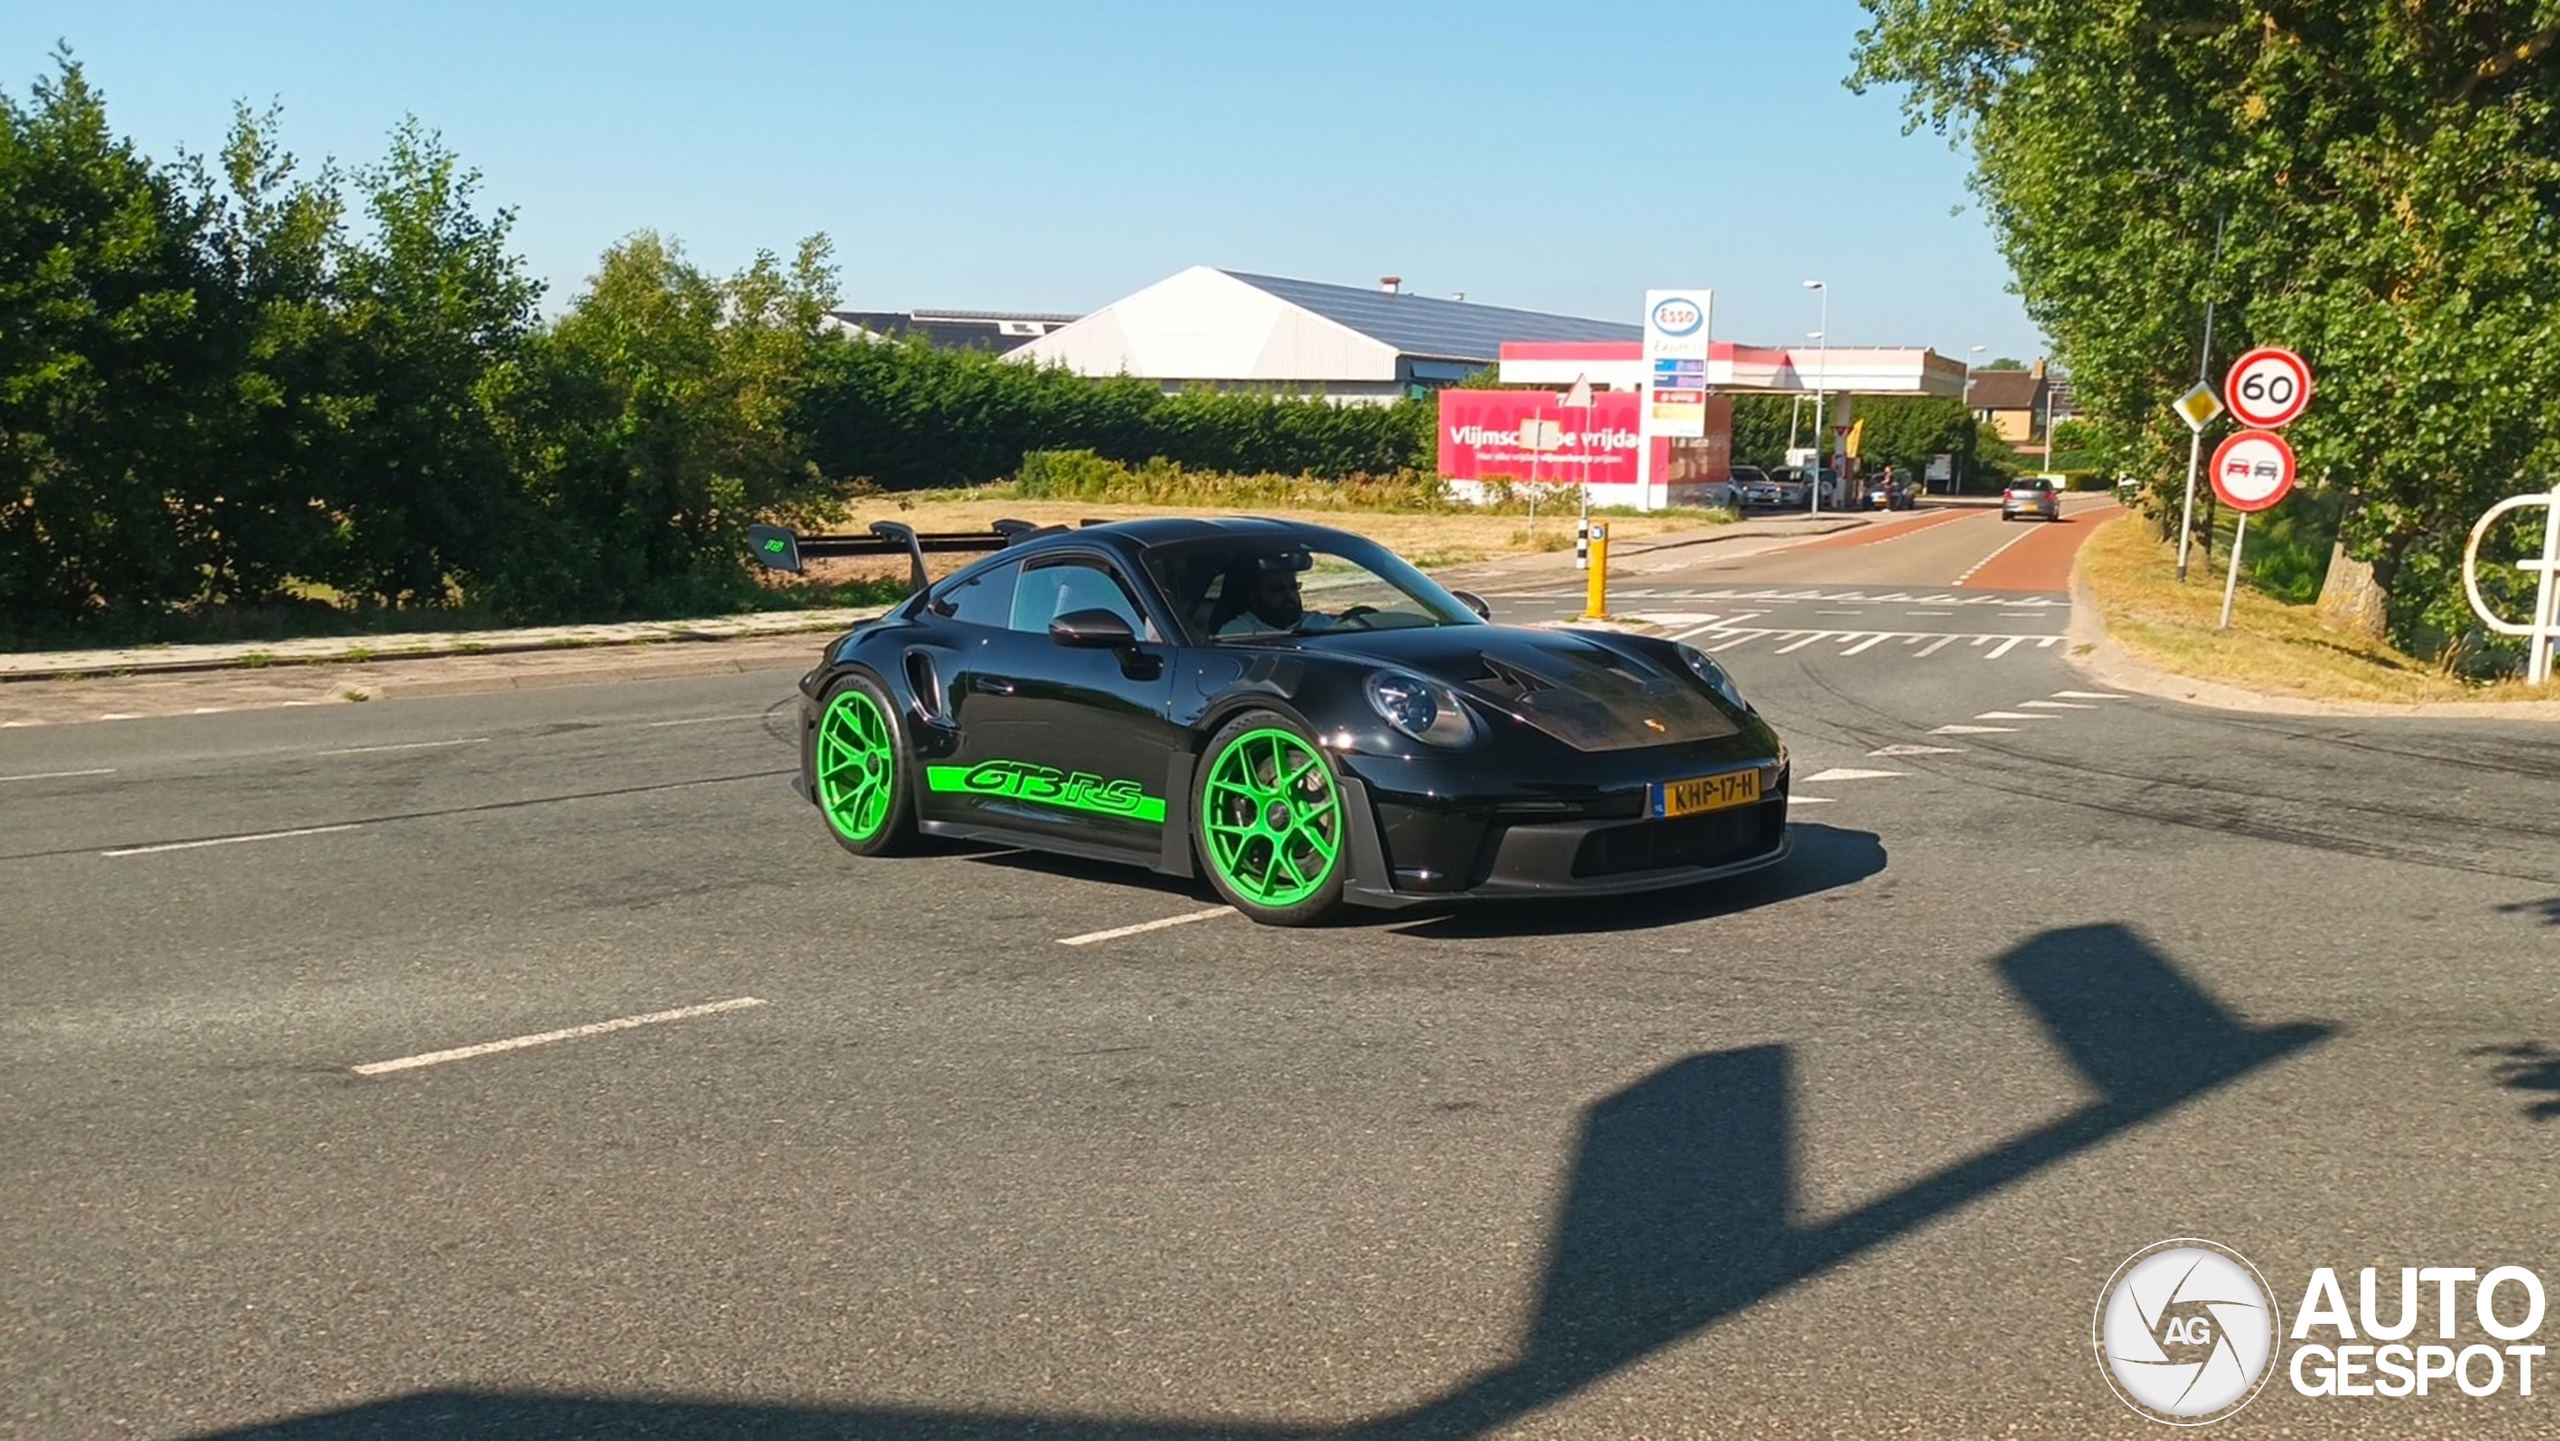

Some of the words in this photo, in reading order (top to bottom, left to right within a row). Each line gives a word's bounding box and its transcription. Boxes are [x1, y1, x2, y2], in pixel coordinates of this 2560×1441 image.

[1660, 307, 1695, 323] Esso
[2242, 373, 2293, 404] 60
[1450, 425, 1576, 449] Vlijmsce
[1581, 427, 1640, 452] vrijda
[964, 760, 1064, 798] GT3
[1064, 771, 1143, 812] RS
[1675, 772, 1753, 811] KHP-17-H
